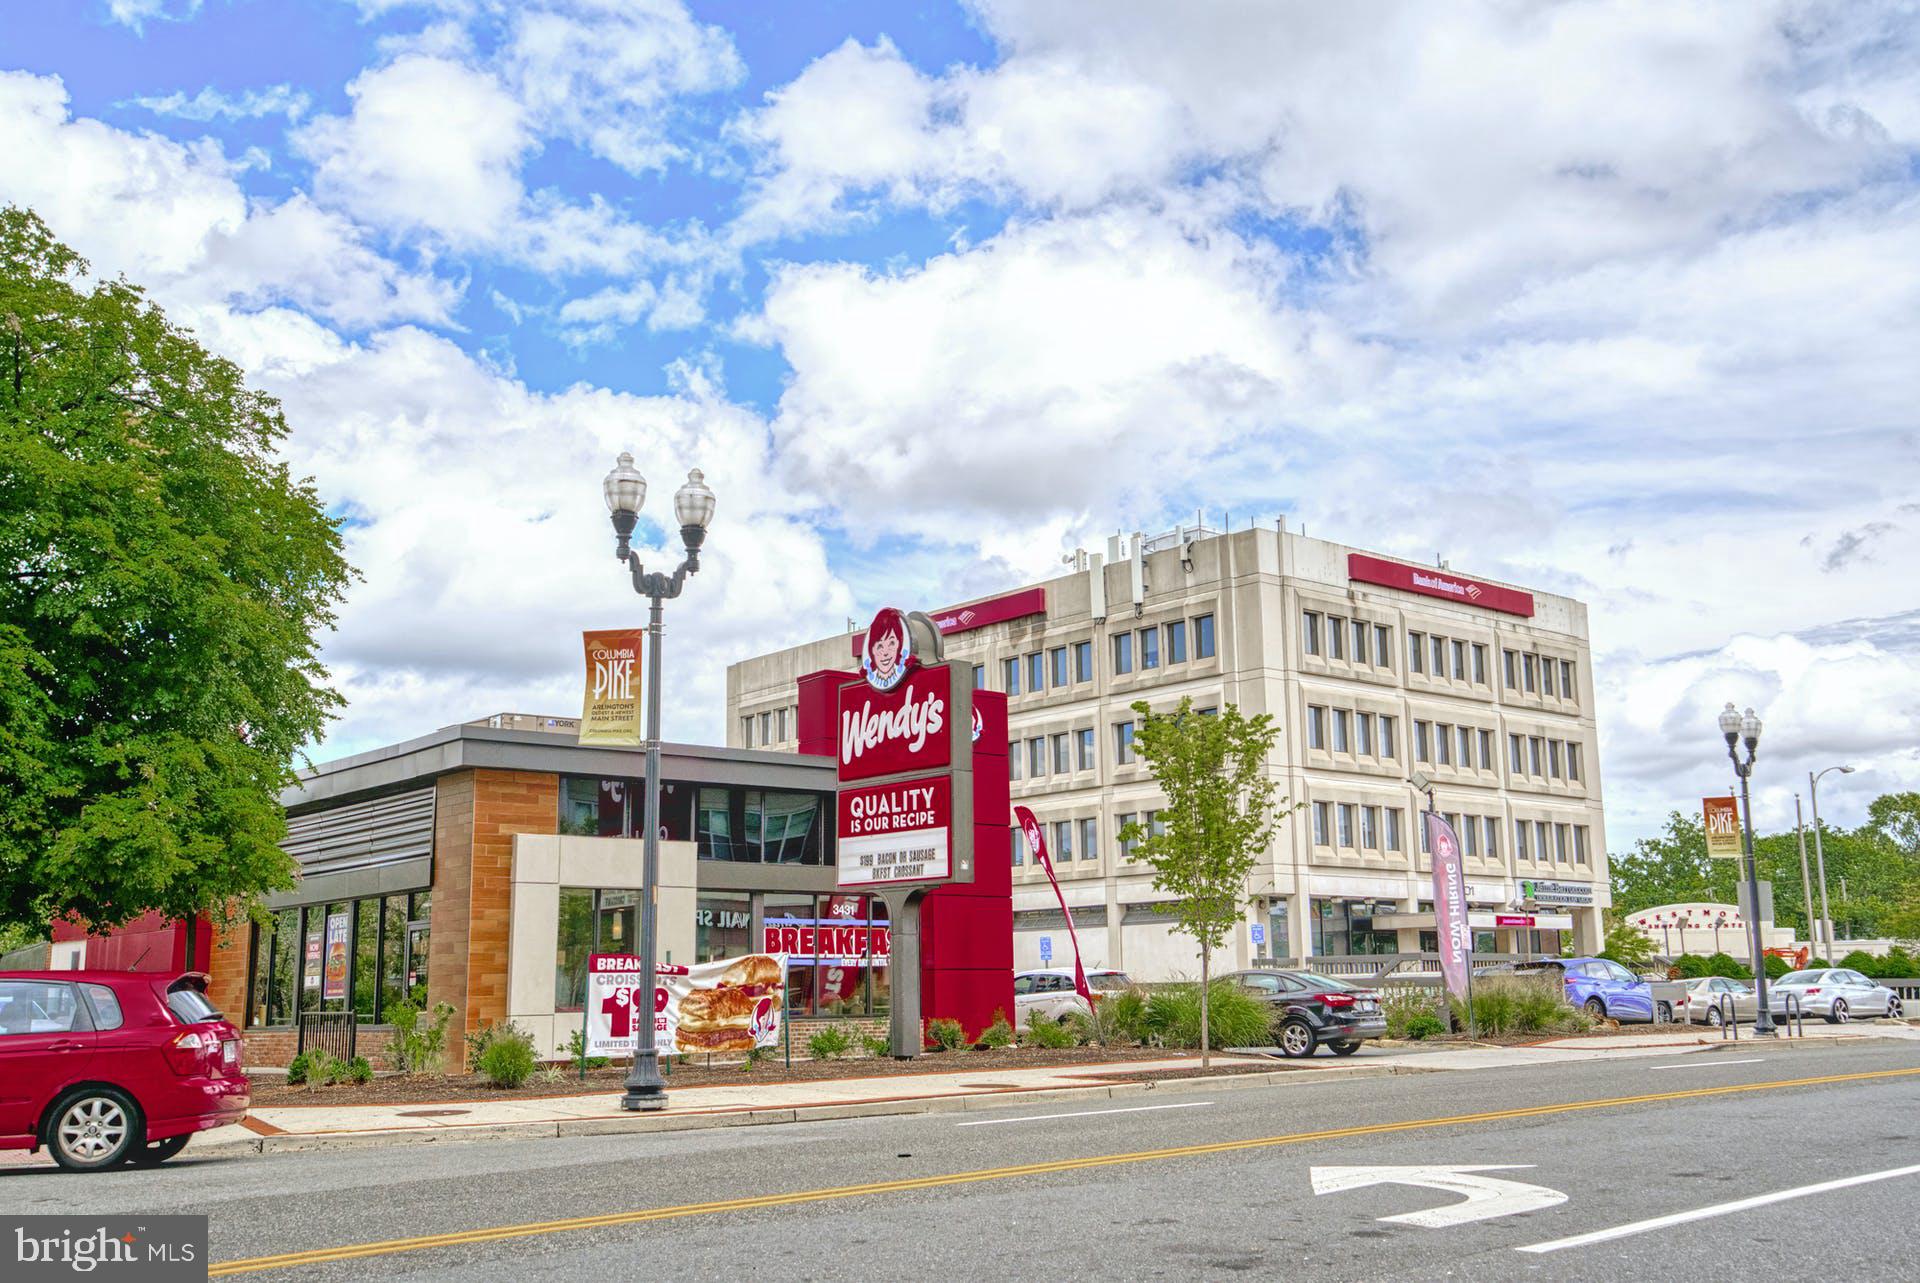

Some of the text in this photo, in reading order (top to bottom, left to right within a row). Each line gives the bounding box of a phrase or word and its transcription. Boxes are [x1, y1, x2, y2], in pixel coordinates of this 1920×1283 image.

[592, 648, 635, 660] COLUMBIA
[592, 659, 635, 700] PIKE
[554, 719, 575, 728] YORK
[842, 685, 944, 765] Wendy's
[850, 787, 935, 818] QUALITY
[851, 810, 935, 833] IS OUR RECIPE
[1709, 812, 1735, 834] PIKE
[878, 852, 897, 866] BACON
[899, 850, 907, 863] OR
[909, 848, 936, 862] SAUSAGE
[872, 863, 925, 880] BKFST CROSSANT
[832, 904, 855, 915] 3431
[330, 916, 348, 929] OPEN
[329, 928, 347, 944] LATE
[596, 957, 679, 973] BREAKAST
[595, 1040, 630, 1049] LIMITED
